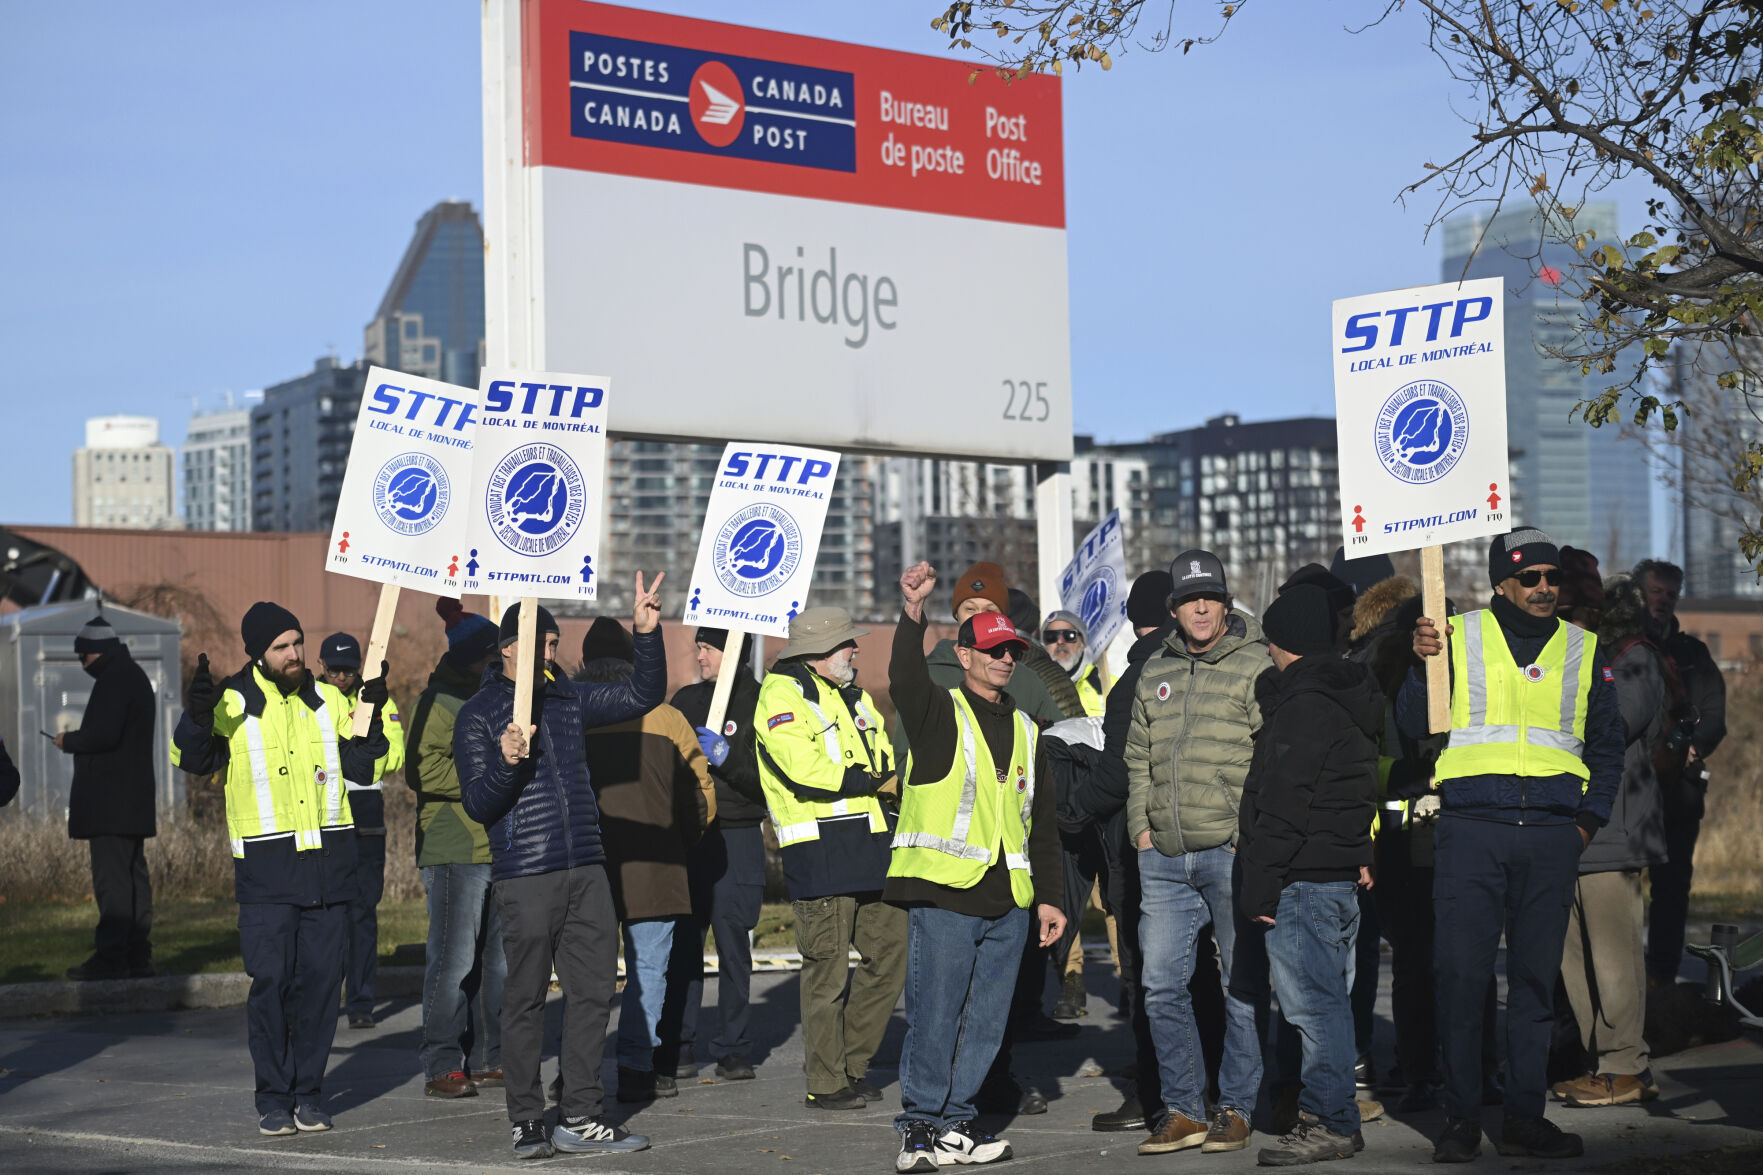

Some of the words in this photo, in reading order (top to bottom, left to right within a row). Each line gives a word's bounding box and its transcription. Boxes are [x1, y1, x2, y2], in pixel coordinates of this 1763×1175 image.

[583, 51, 669, 84] POSTES
[752, 76, 843, 109] CANADA
[584, 102, 682, 135] CANADA
[880, 90, 949, 131] Bureau
[985, 106, 1027, 142] Post
[752, 125, 808, 151] POST
[881, 132, 906, 167] de
[911, 145, 965, 177] poste
[985, 148, 1042, 186] Office
[742, 242, 899, 350] Bridge
[1341, 295, 1494, 354] STTP
[1349, 356, 1394, 374] LOCAL
[1399, 353, 1418, 367] DE
[1421, 341, 1495, 363] MONTRÉAL
[484, 380, 604, 419] STTP
[1002, 379, 1051, 423] 225
[1419, 383, 1426, 397] ET
[482, 417, 518, 429] LOCAL
[522, 420, 540, 430] DE
[542, 421, 601, 435] MONTRÉAL
[1378, 417, 1392, 430] DES
[1453, 412, 1466, 426] DES
[369, 419, 404, 436] LOCAL
[408, 428, 424, 440] DE
[426, 432, 474, 450] MONTRÉ
[1378, 432, 1395, 462] SYNDICAT
[1451, 425, 1466, 450] POSTES
[498, 446, 538, 478] TRAVAILLEURS
[538, 446, 546, 460] ET
[492, 474, 507, 489] DES
[723, 451, 833, 486] STTP
[1392, 460, 1412, 479] SECTION
[1410, 467, 1428, 481] LOCALE
[1427, 466, 1435, 479] DE
[569, 485, 582, 498] DES
[719, 480, 750, 491] LOCAL
[753, 484, 765, 493] DE
[767, 485, 825, 500] MONTRÉAL
[489, 489, 505, 523] SYNDICAT
[565, 498, 582, 525] POSTES
[1487, 512, 1503, 522] FTQ
[1383, 508, 1479, 535] STTPMTL.COM
[498, 524, 521, 548] SECTION
[518, 535, 538, 553] LOCALE
[538, 537, 545, 553] DE
[1352, 535, 1368, 545] FTQ
[360, 553, 439, 579] STTPMTL.COM
[1062, 516, 1117, 600] STTP
[463, 579, 479, 589] FTQ
[487, 571, 572, 585] STTPMTL.COM
[578, 585, 594, 595] FTQ
[705, 607, 778, 624] STTPMTL.COM
